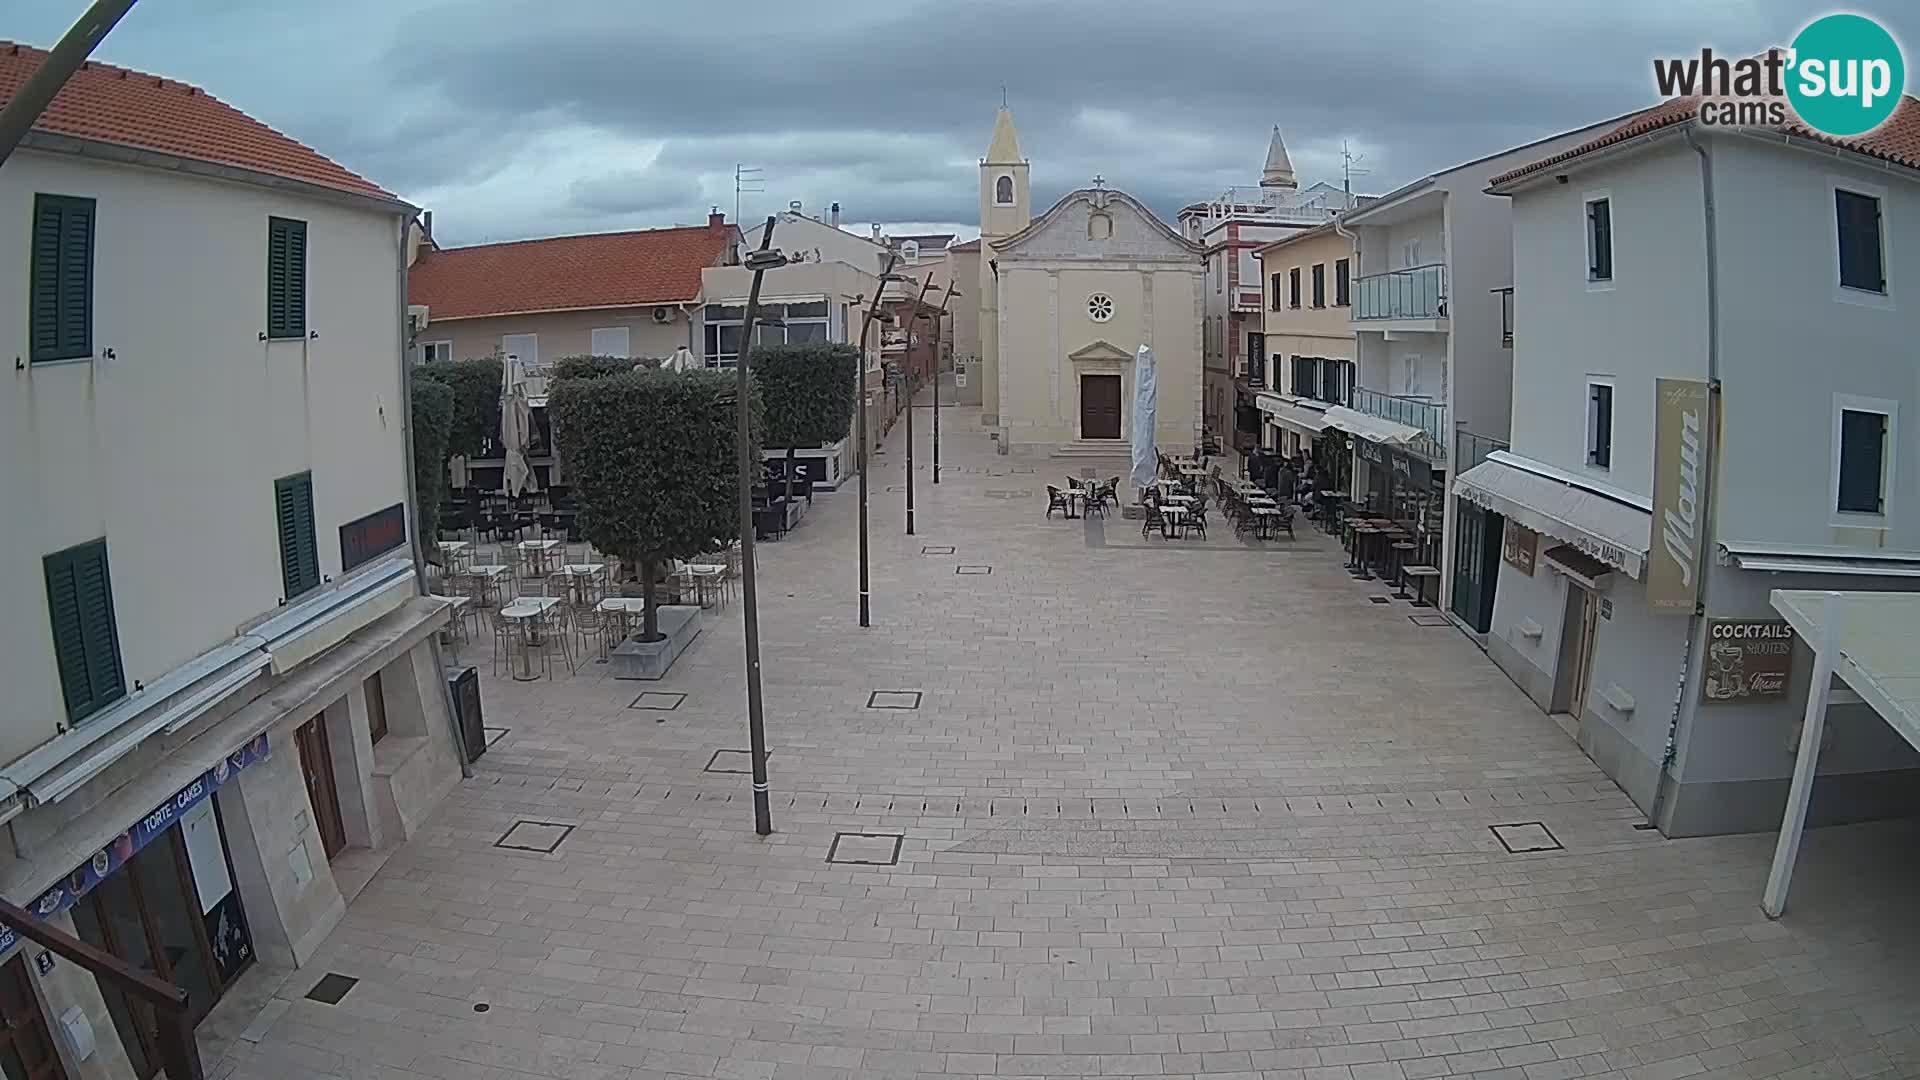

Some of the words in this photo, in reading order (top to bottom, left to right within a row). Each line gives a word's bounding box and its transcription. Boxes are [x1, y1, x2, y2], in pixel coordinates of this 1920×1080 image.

[1663, 408, 1700, 587] Maun
[1712, 624, 1792, 639] COCKTAILS
[144, 803, 172, 832] TORTE
[177, 780, 203, 808] CAKES
